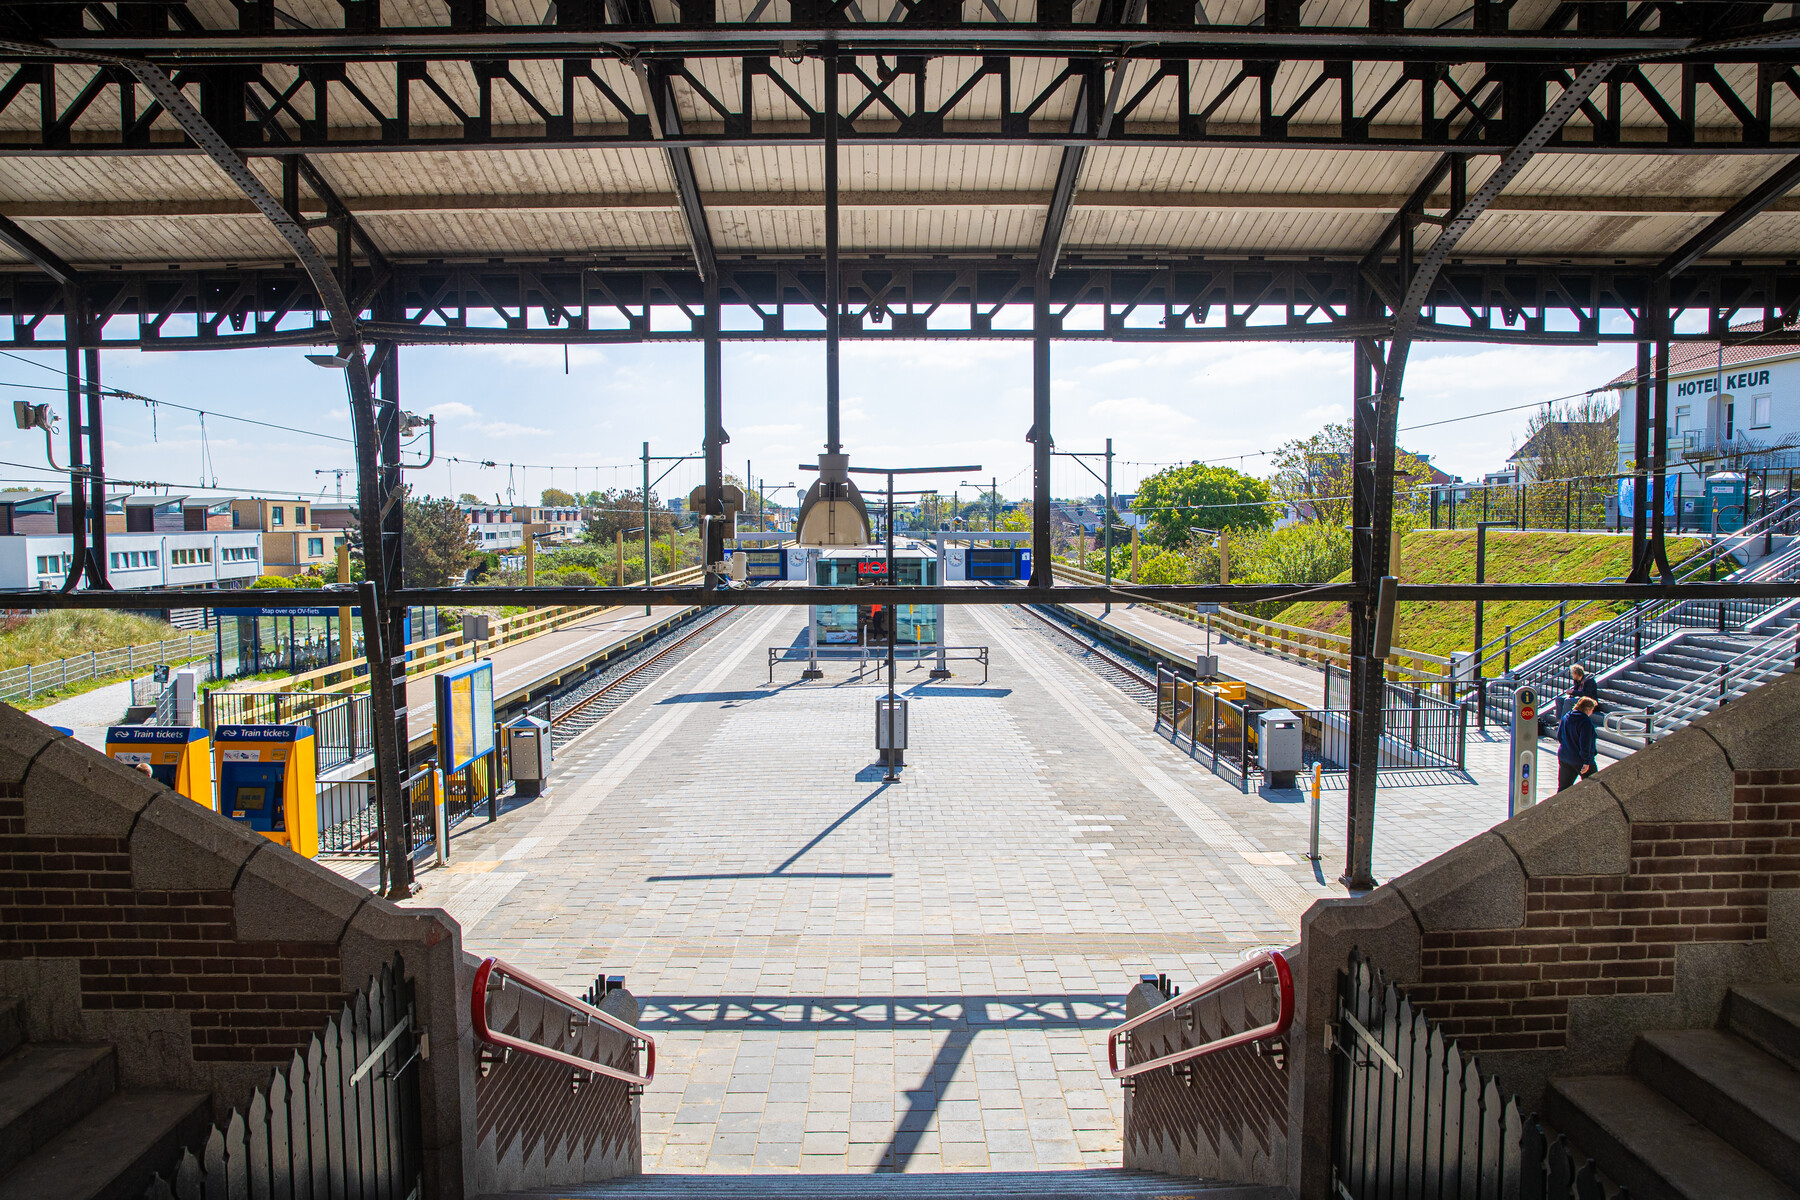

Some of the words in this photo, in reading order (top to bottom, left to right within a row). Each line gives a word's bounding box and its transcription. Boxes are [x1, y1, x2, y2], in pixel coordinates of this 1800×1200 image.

[1678, 378, 1718, 397] HOTEL
[1727, 370, 1770, 390] KEUR
[858, 561, 888, 574] KIOS
[133, 730, 153, 738] Train
[156, 730, 183, 738] tickets
[240, 729, 261, 737] Train
[263, 729, 290, 737] tickets
